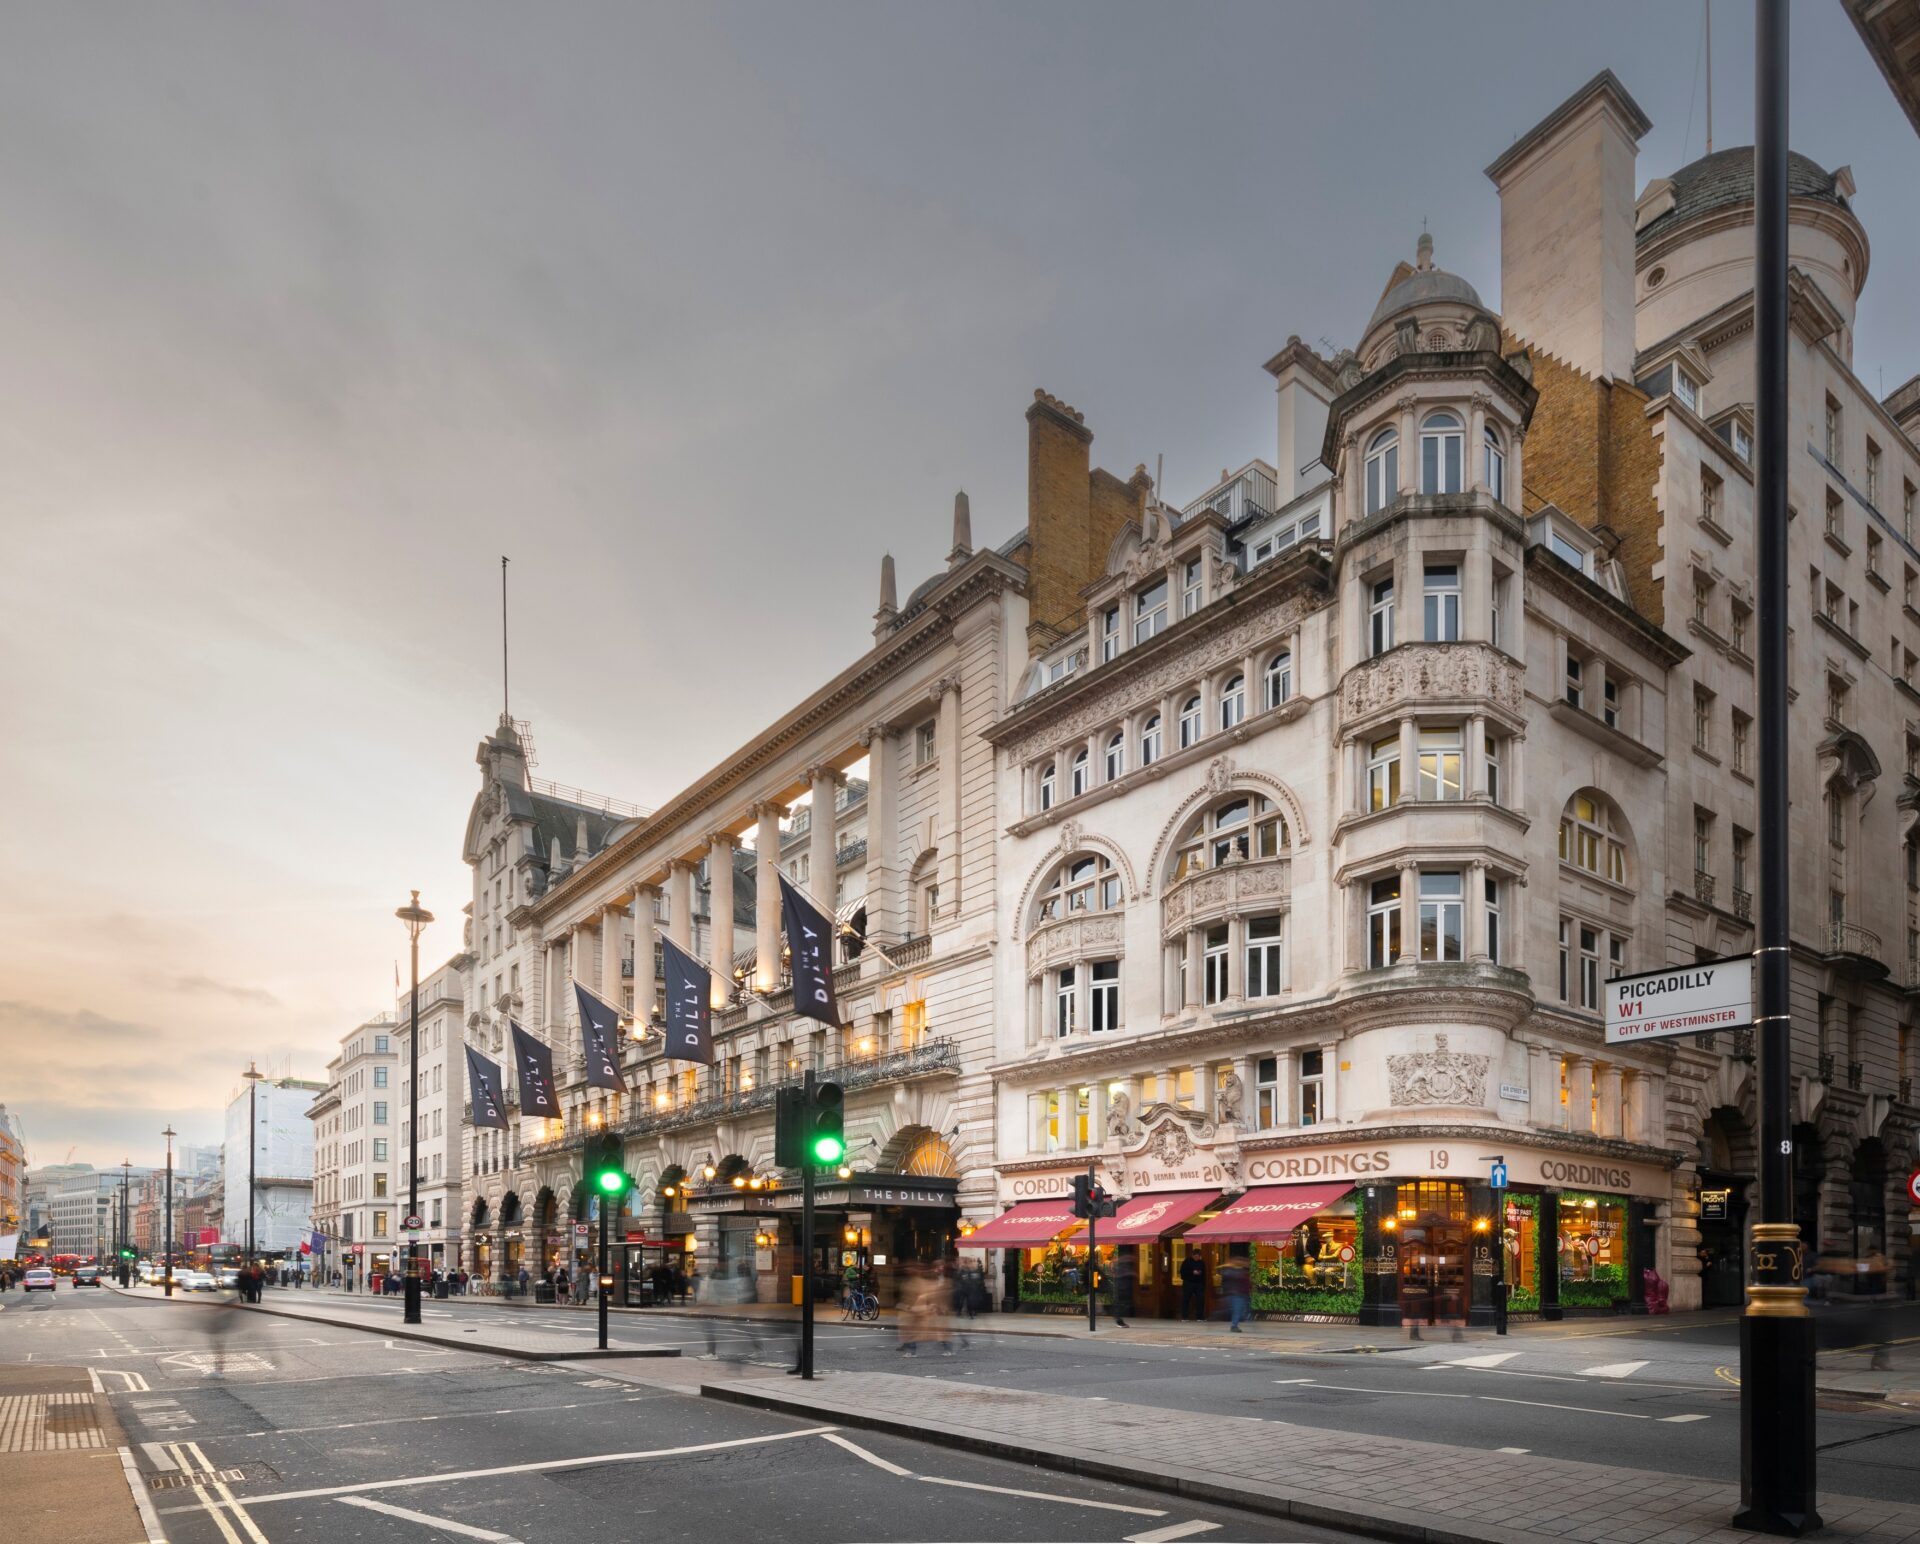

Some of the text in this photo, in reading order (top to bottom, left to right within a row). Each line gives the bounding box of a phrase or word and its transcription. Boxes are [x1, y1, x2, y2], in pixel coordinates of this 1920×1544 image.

[1620, 971, 1714, 1000] PICCADILLY
[684, 978, 698, 1046] DILLY
[1619, 1001, 1642, 1018] W1
[1620, 1011, 1736, 1036] CITY OF WESTMINSTER
[1250, 1151, 1390, 1180] CORDINGS
[1429, 1150, 1449, 1169] 19
[1133, 1171, 1150, 1186] 20
[1203, 1165, 1222, 1182] 20
[1540, 1160, 1631, 1188] CORDINGS
[758, 1198, 775, 1206] TH
[864, 1189, 945, 1202] THE DILLY
[1225, 1201, 1323, 1215] CORDINGS
[1381, 1246, 1394, 1257] 19
[1475, 1247, 1488, 1258] 19
